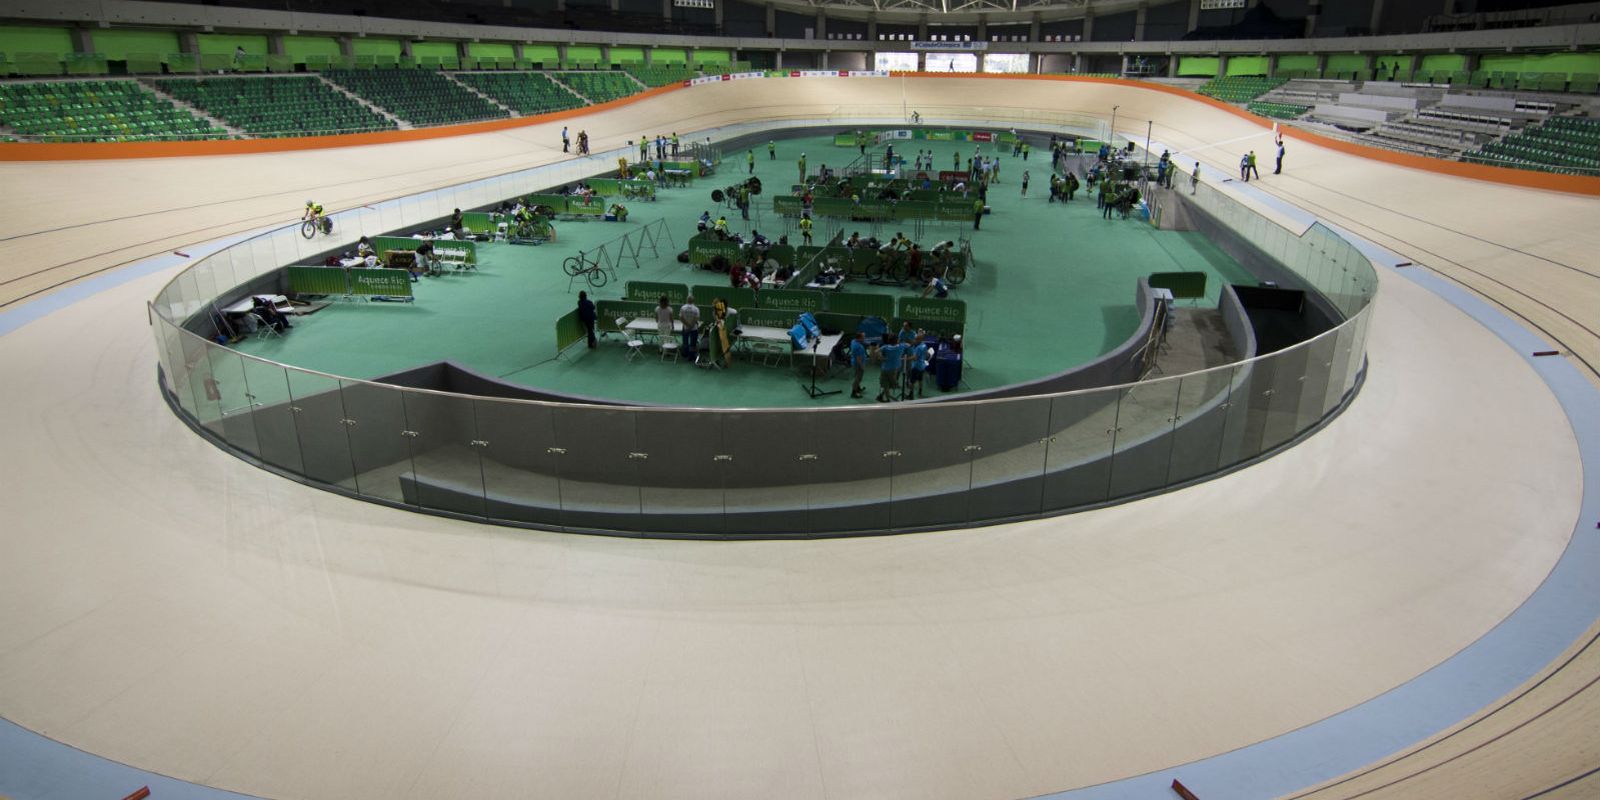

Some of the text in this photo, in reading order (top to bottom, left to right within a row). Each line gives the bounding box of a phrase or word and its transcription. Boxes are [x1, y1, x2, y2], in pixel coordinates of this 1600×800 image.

[358, 275, 389, 286] Aquece
[766, 295, 816, 308] Aquece Rio
[905, 304, 959, 316] Aquece Rio
[747, 316, 784, 327] Aquece
